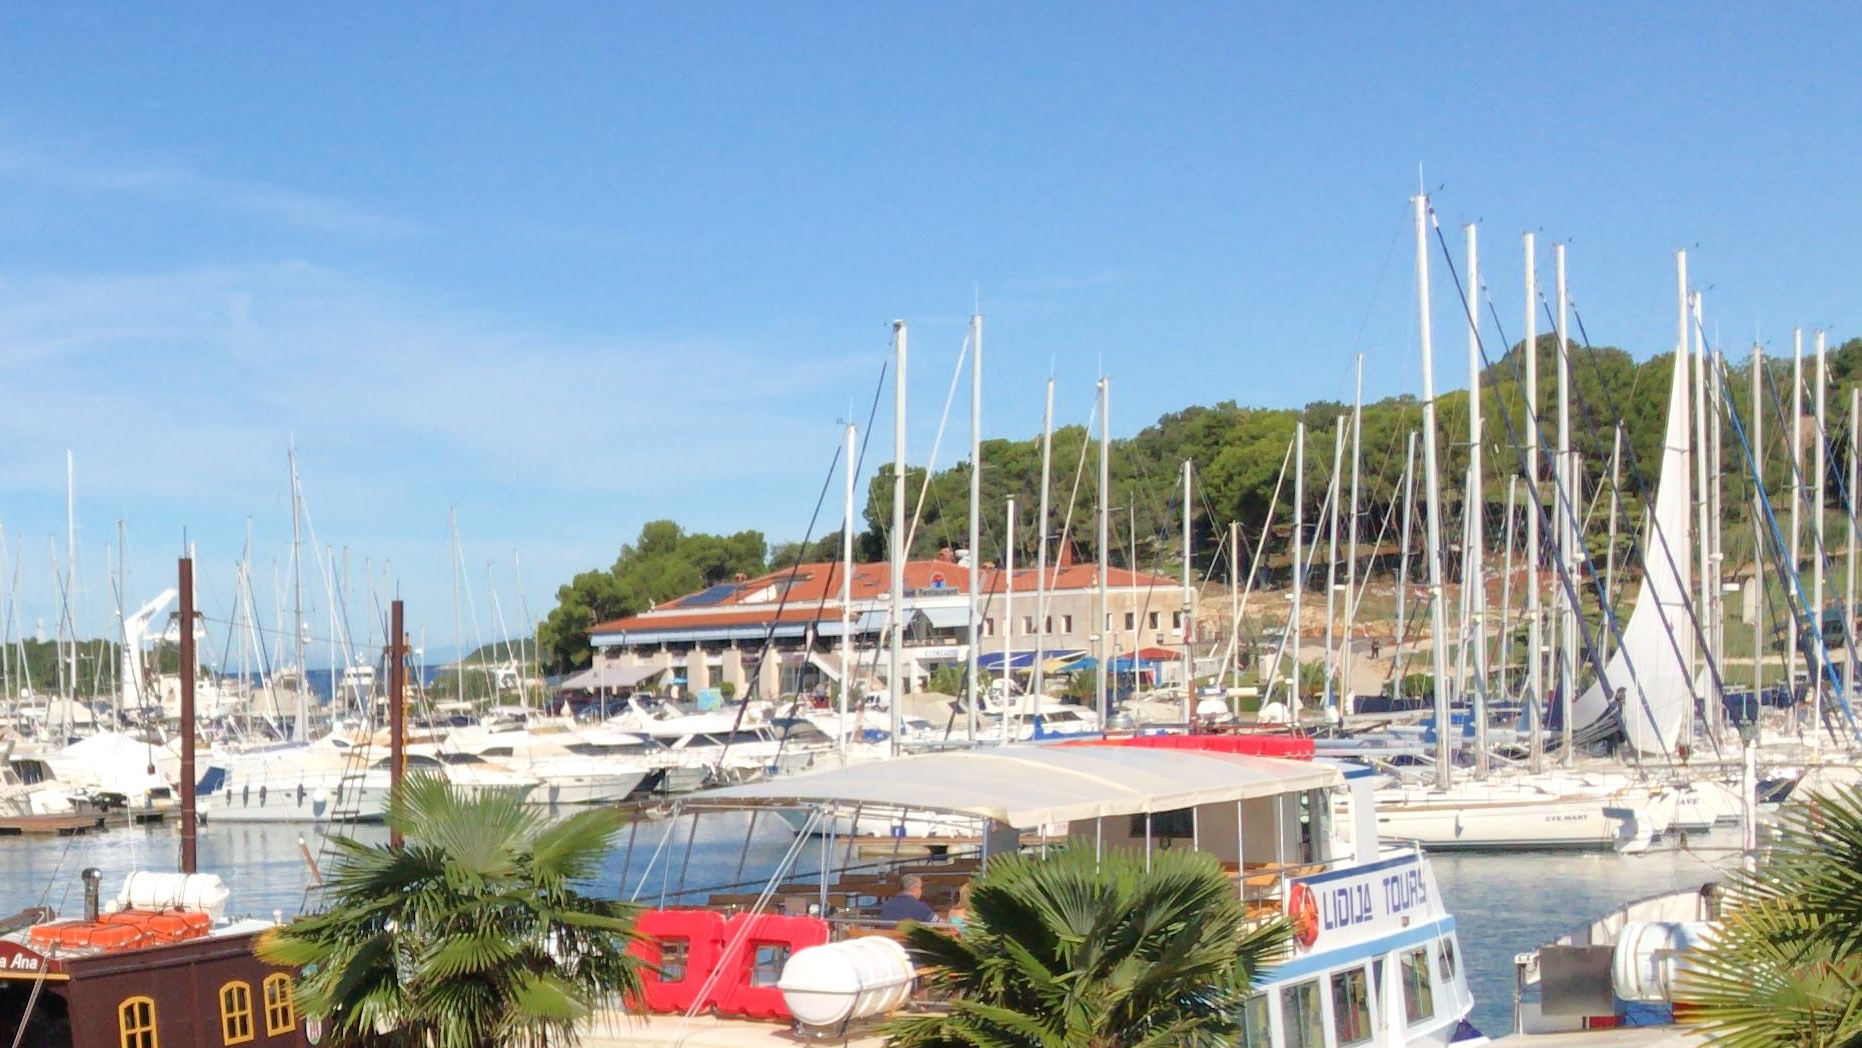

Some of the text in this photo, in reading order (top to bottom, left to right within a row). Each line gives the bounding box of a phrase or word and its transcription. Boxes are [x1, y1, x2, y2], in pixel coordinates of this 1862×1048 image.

[1322, 869, 1427, 931] LIDIJA TOURS
[9, 953, 38, 970] Ana
